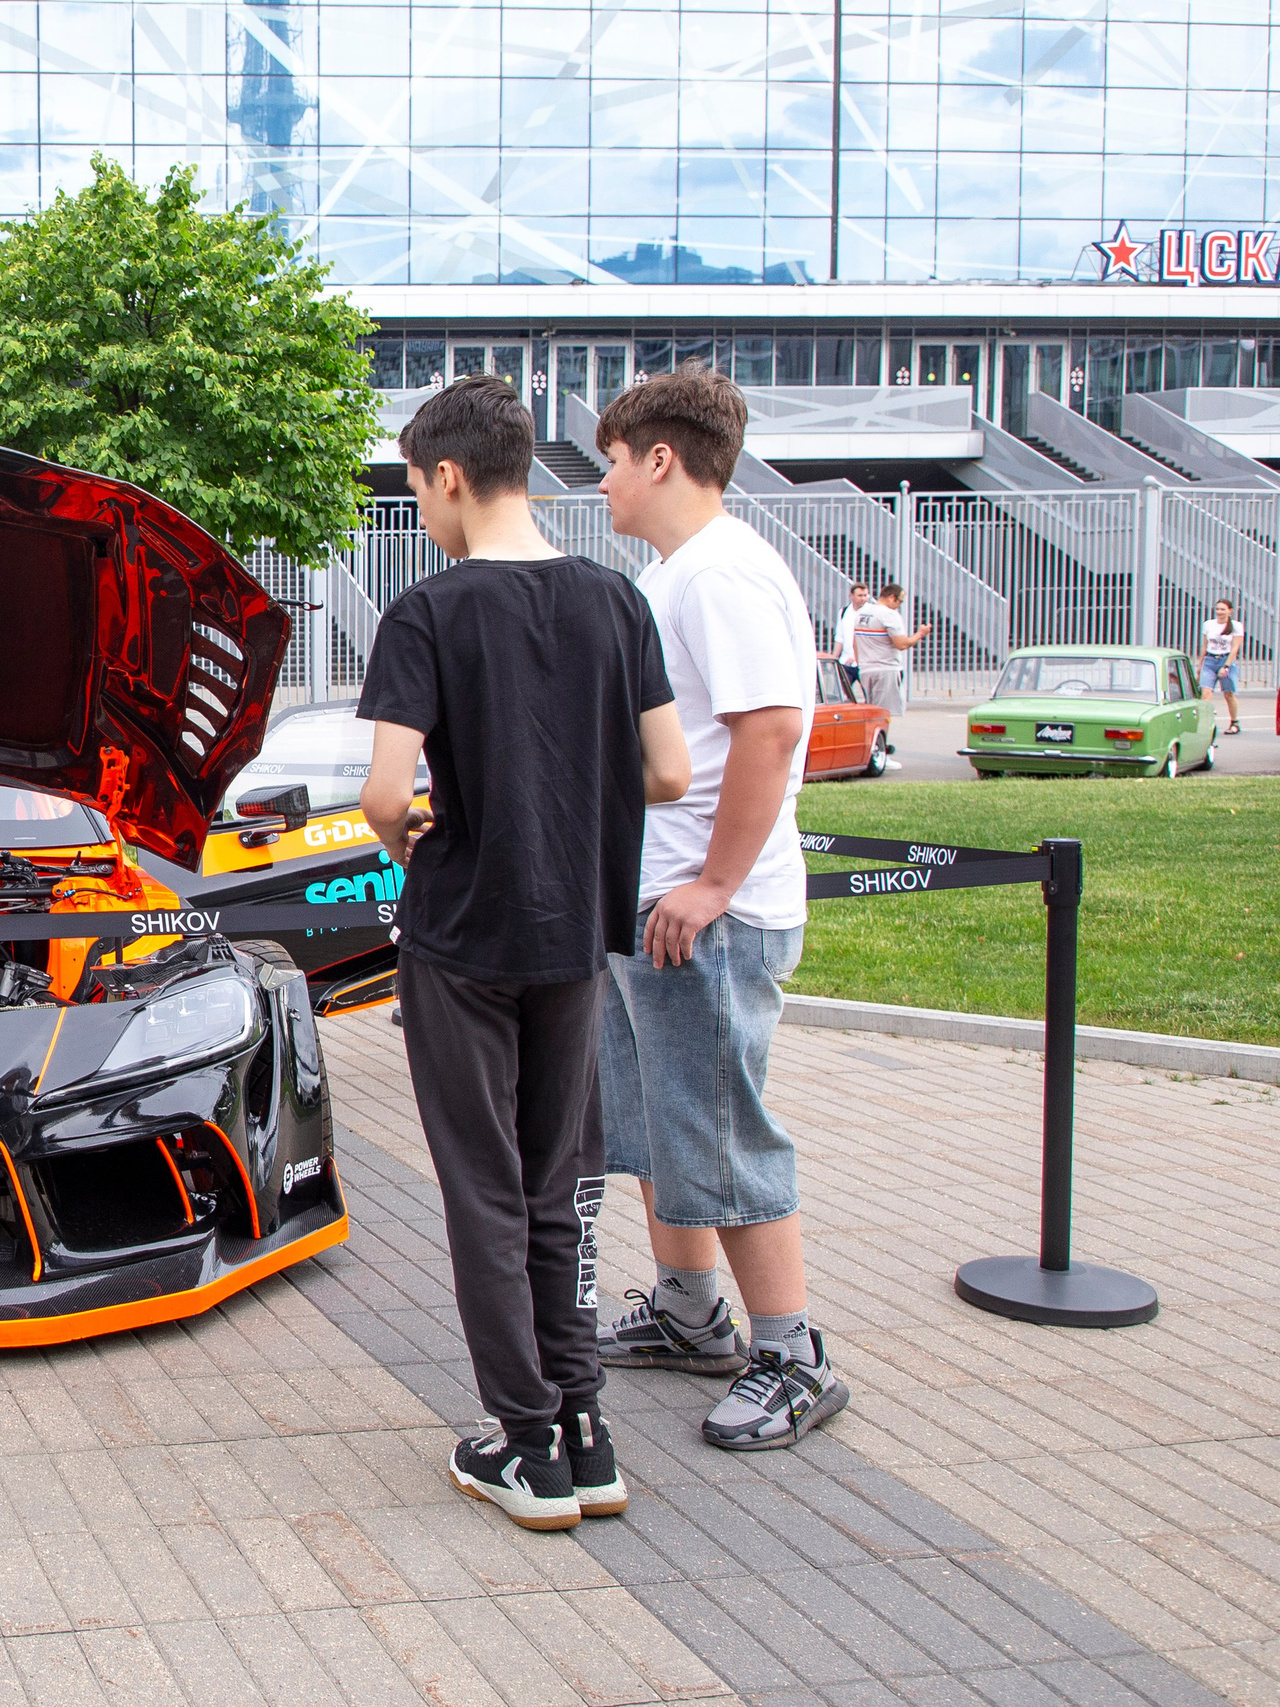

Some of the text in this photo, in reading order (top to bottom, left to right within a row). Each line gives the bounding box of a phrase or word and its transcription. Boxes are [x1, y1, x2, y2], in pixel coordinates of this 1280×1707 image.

[1159, 229, 1280, 287] ЦСК
[250, 763, 284, 774] SHIKOV
[907, 845, 957, 865] SHIKOV
[849, 869, 932, 893] SHIKOV
[131, 911, 220, 933] SHIKOV
[294, 1156, 319, 1174] POWER
[294, 1165, 321, 1182] WHEELS
